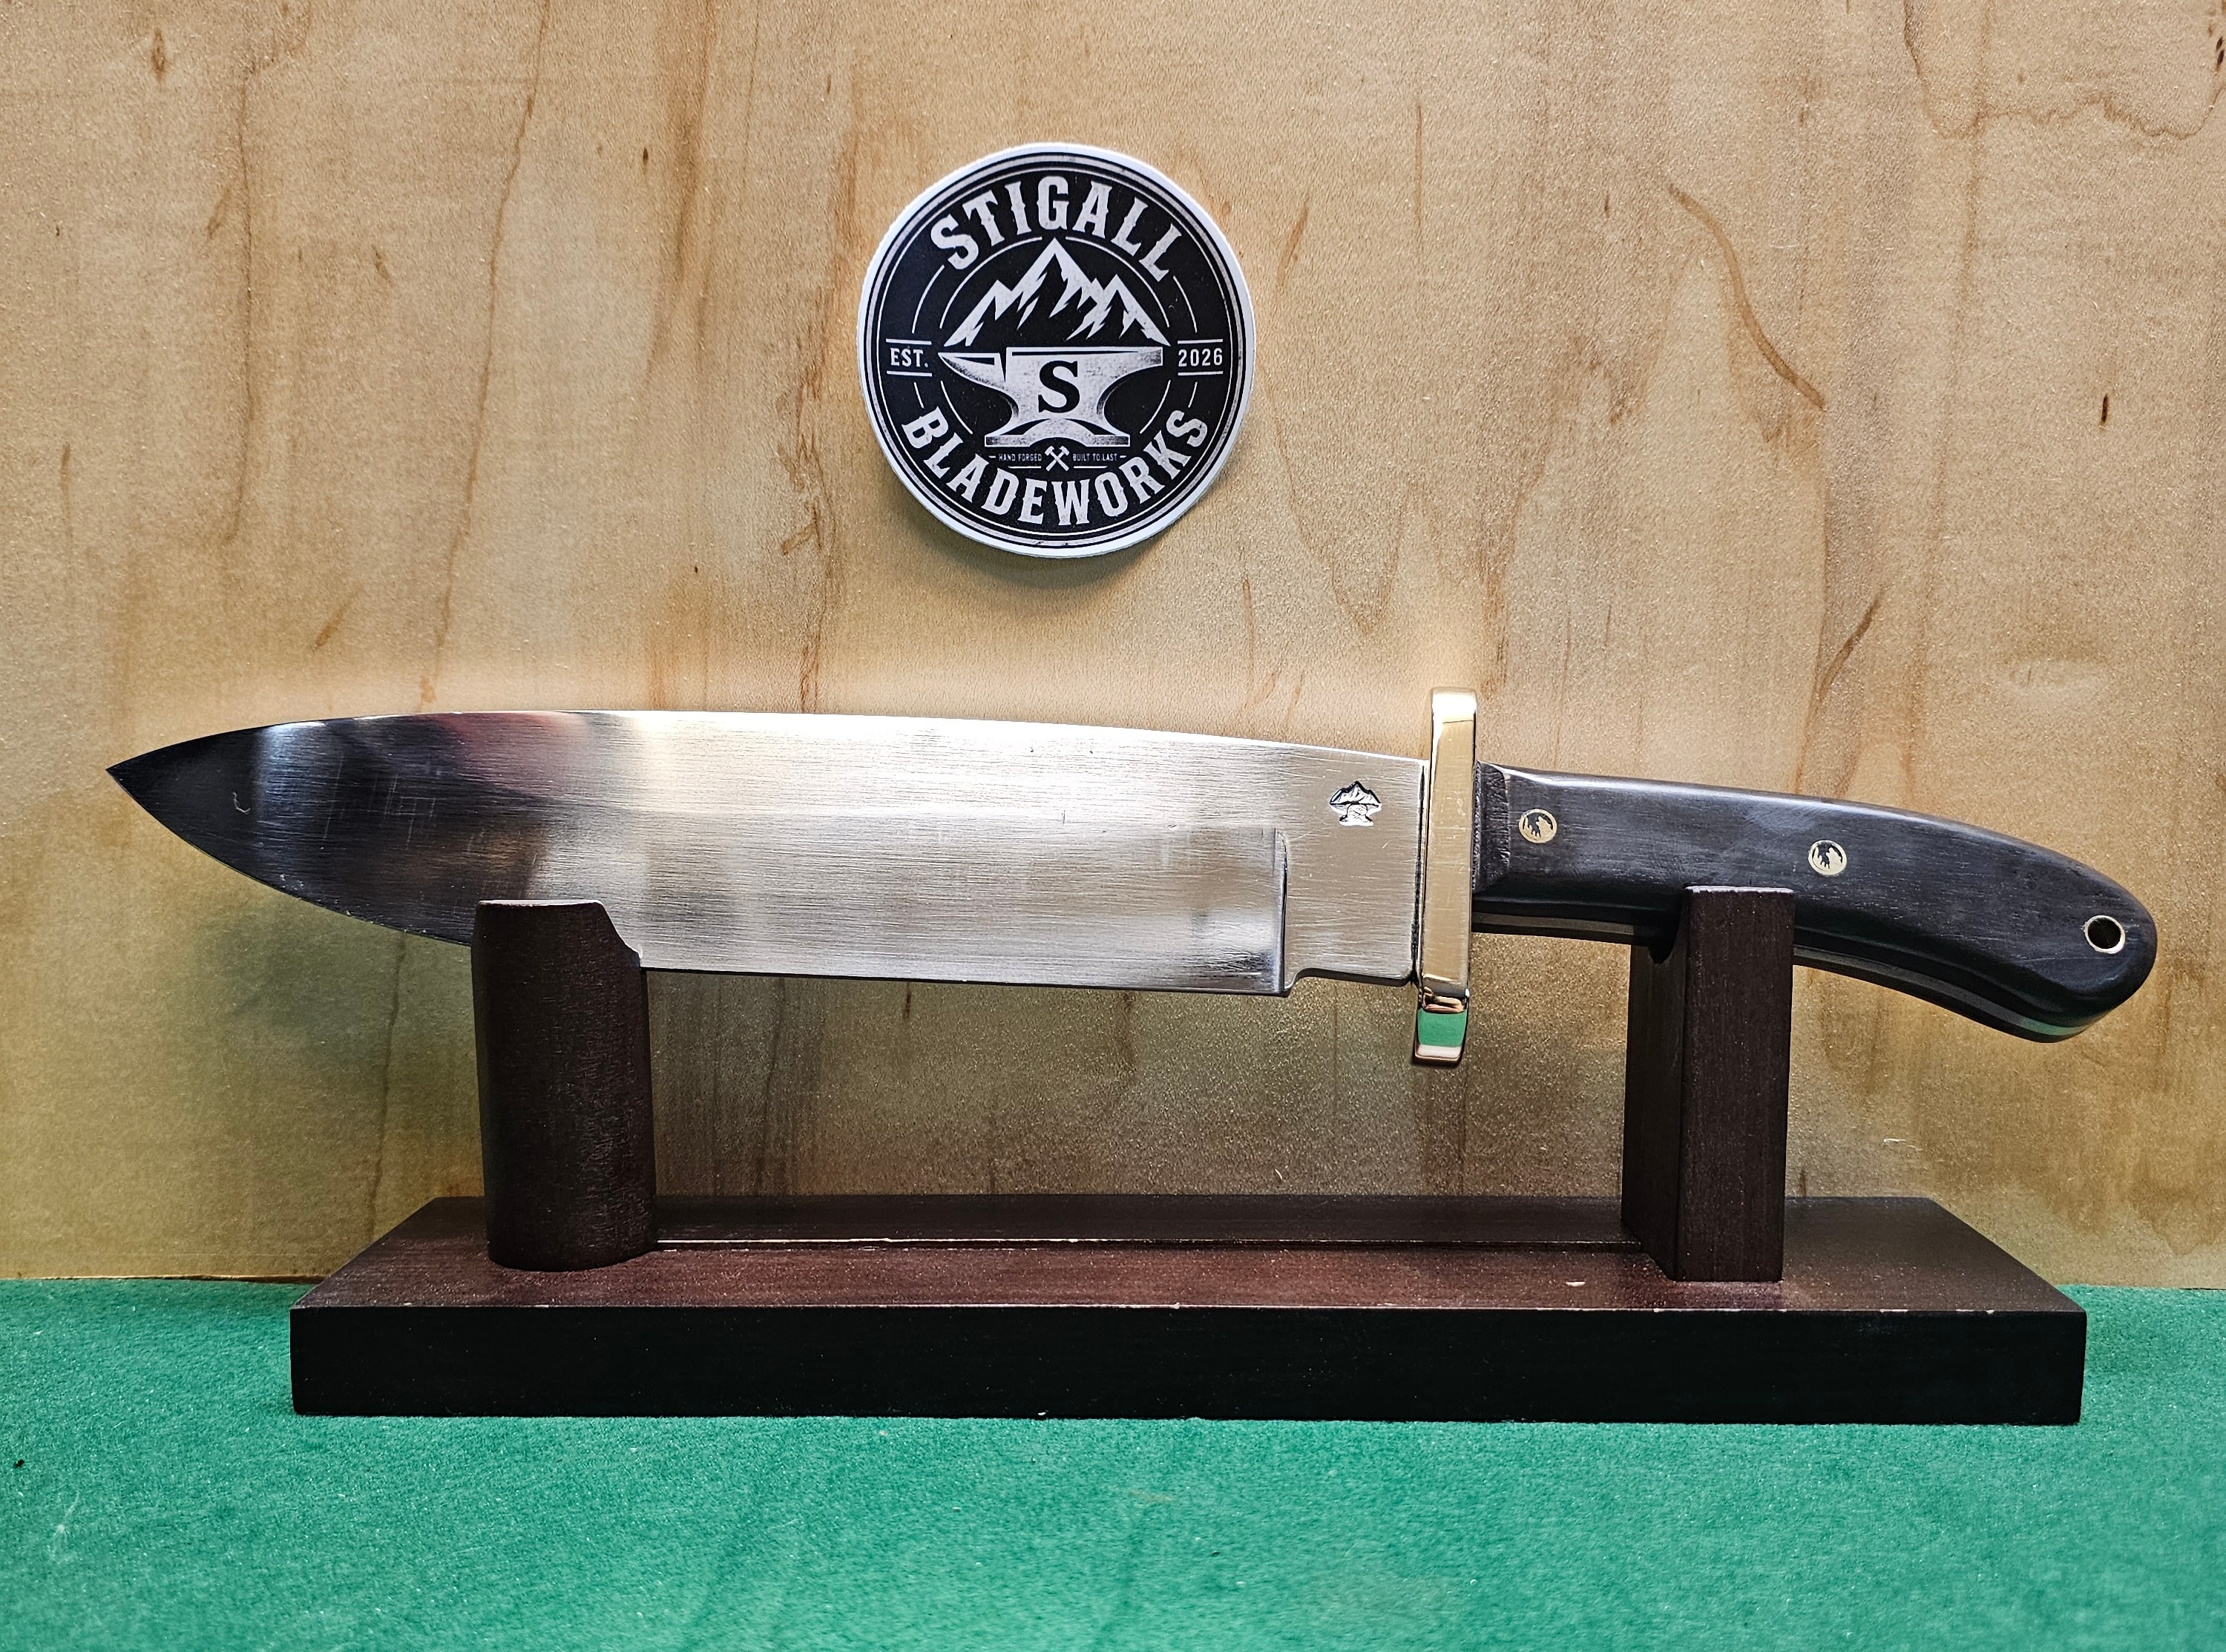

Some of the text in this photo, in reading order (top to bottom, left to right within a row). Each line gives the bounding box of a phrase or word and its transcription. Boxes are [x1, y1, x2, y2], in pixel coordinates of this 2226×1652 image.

[930, 175, 1183, 282] STIGALL
[890, 349, 929, 367] EST.
[1178, 349, 1224, 366] 2026
[1037, 360, 1080, 414] S
[902, 406, 1209, 525] BLADEWORKS
[998, 453, 1043, 461] HAND FORGED
[1073, 453, 1118, 461] BUILT TO LAST
